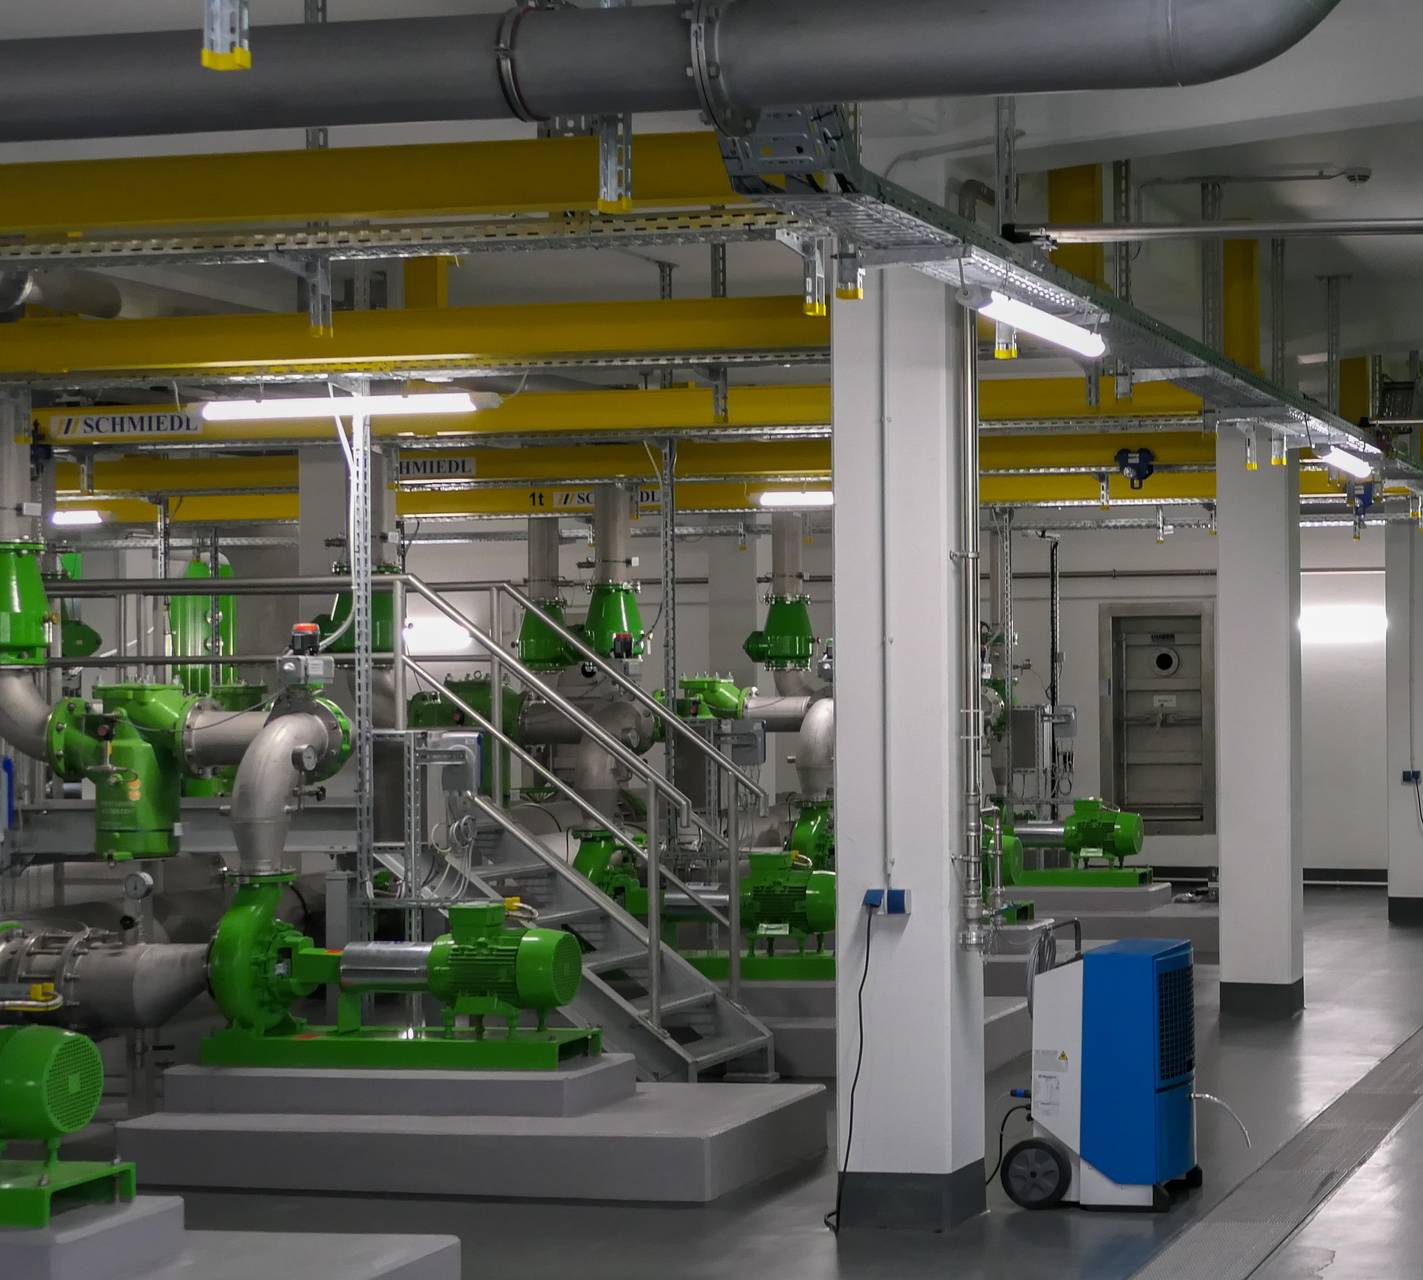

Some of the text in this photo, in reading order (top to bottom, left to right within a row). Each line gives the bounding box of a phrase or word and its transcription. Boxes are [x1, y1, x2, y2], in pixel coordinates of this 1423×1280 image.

[83, 415, 198, 434] SCHMIEDL
[400, 460, 472, 474] HMIEDL
[529, 492, 544, 506] 1t
